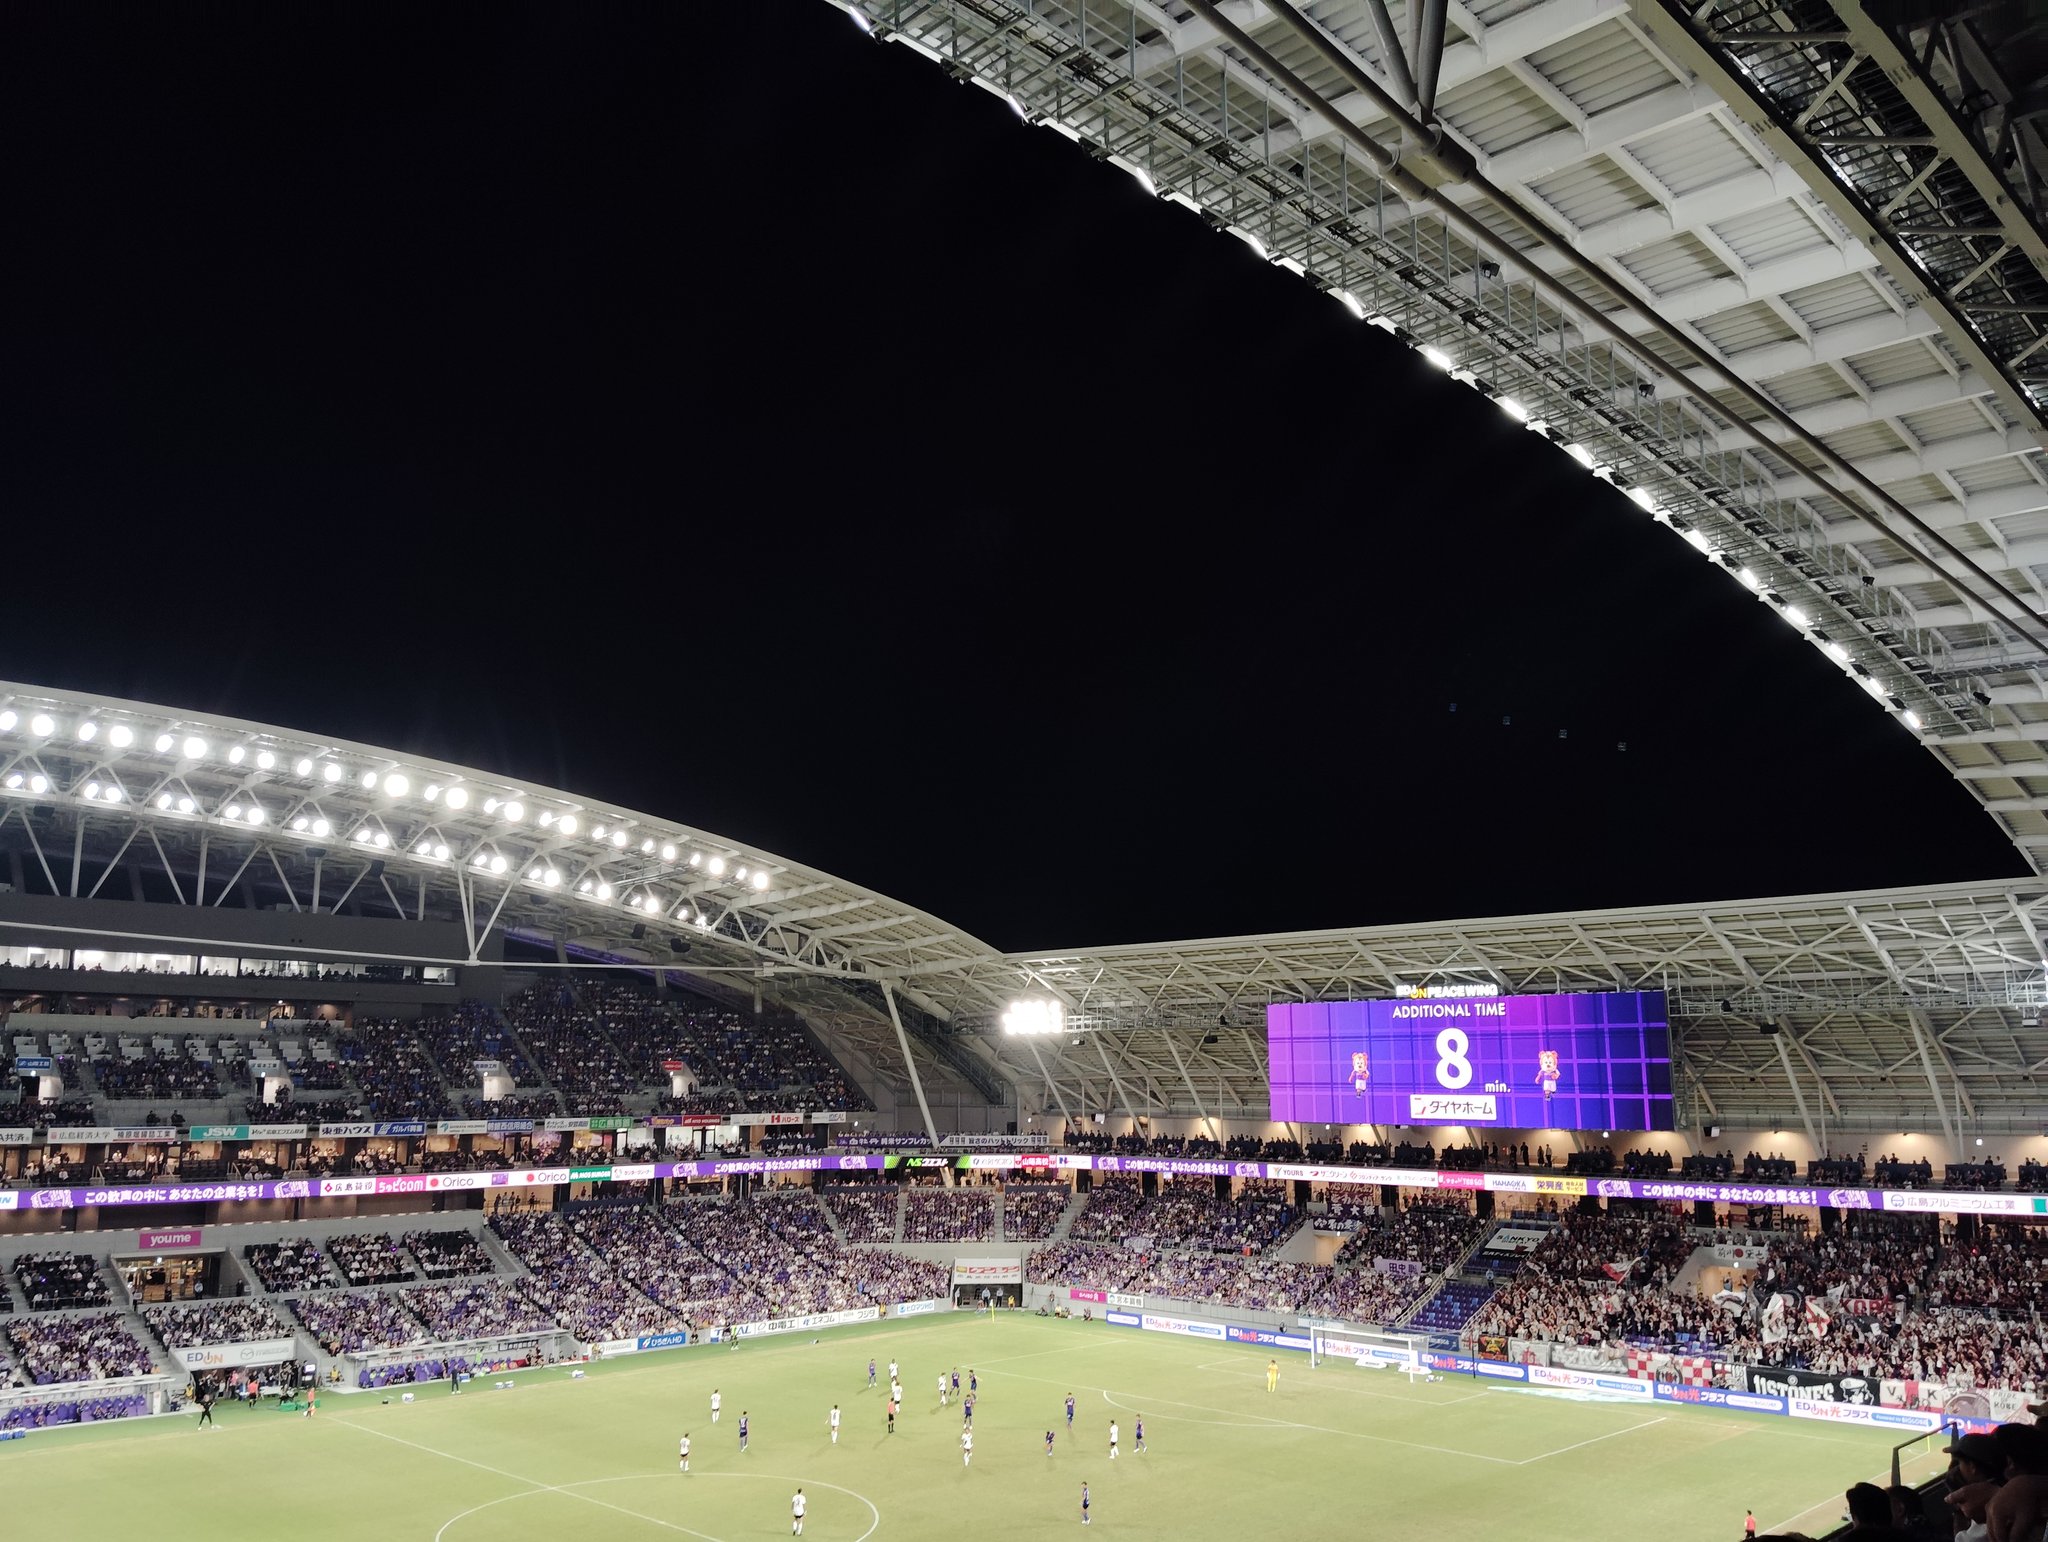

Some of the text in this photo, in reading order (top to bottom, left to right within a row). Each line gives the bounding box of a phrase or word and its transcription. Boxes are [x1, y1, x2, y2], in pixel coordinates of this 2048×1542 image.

[1395, 983, 1498, 998] EDION PEACE WING
[1392, 1002, 1506, 1018] ADDITIONAL TIME
[1435, 1027, 1473, 1090] 8
[1484, 1080, 1511, 1093] min.
[1429, 1100, 1493, 1114] ダイヤホーム
[58, 1131, 110, 1140] 広島経済大学
[203, 1127, 238, 1137] JSW
[321, 1126, 372, 1135] 東亜ハウス
[538, 1172, 567, 1183] Orico
[1283, 1169, 1304, 1177] YOURS
[442, 1176, 474, 1187] Orico
[1907, 1196, 2016, 1211] 広島アルミニウム工業
[150, 1232, 192, 1246] youme
[811, 1315, 836, 1326] エネコム
[856, 1309, 876, 1320] フジタ
[768, 1319, 796, 1332] 中電工
[187, 1351, 224, 1365] EDION
[1994, 1402, 2017, 1410] KOBE
